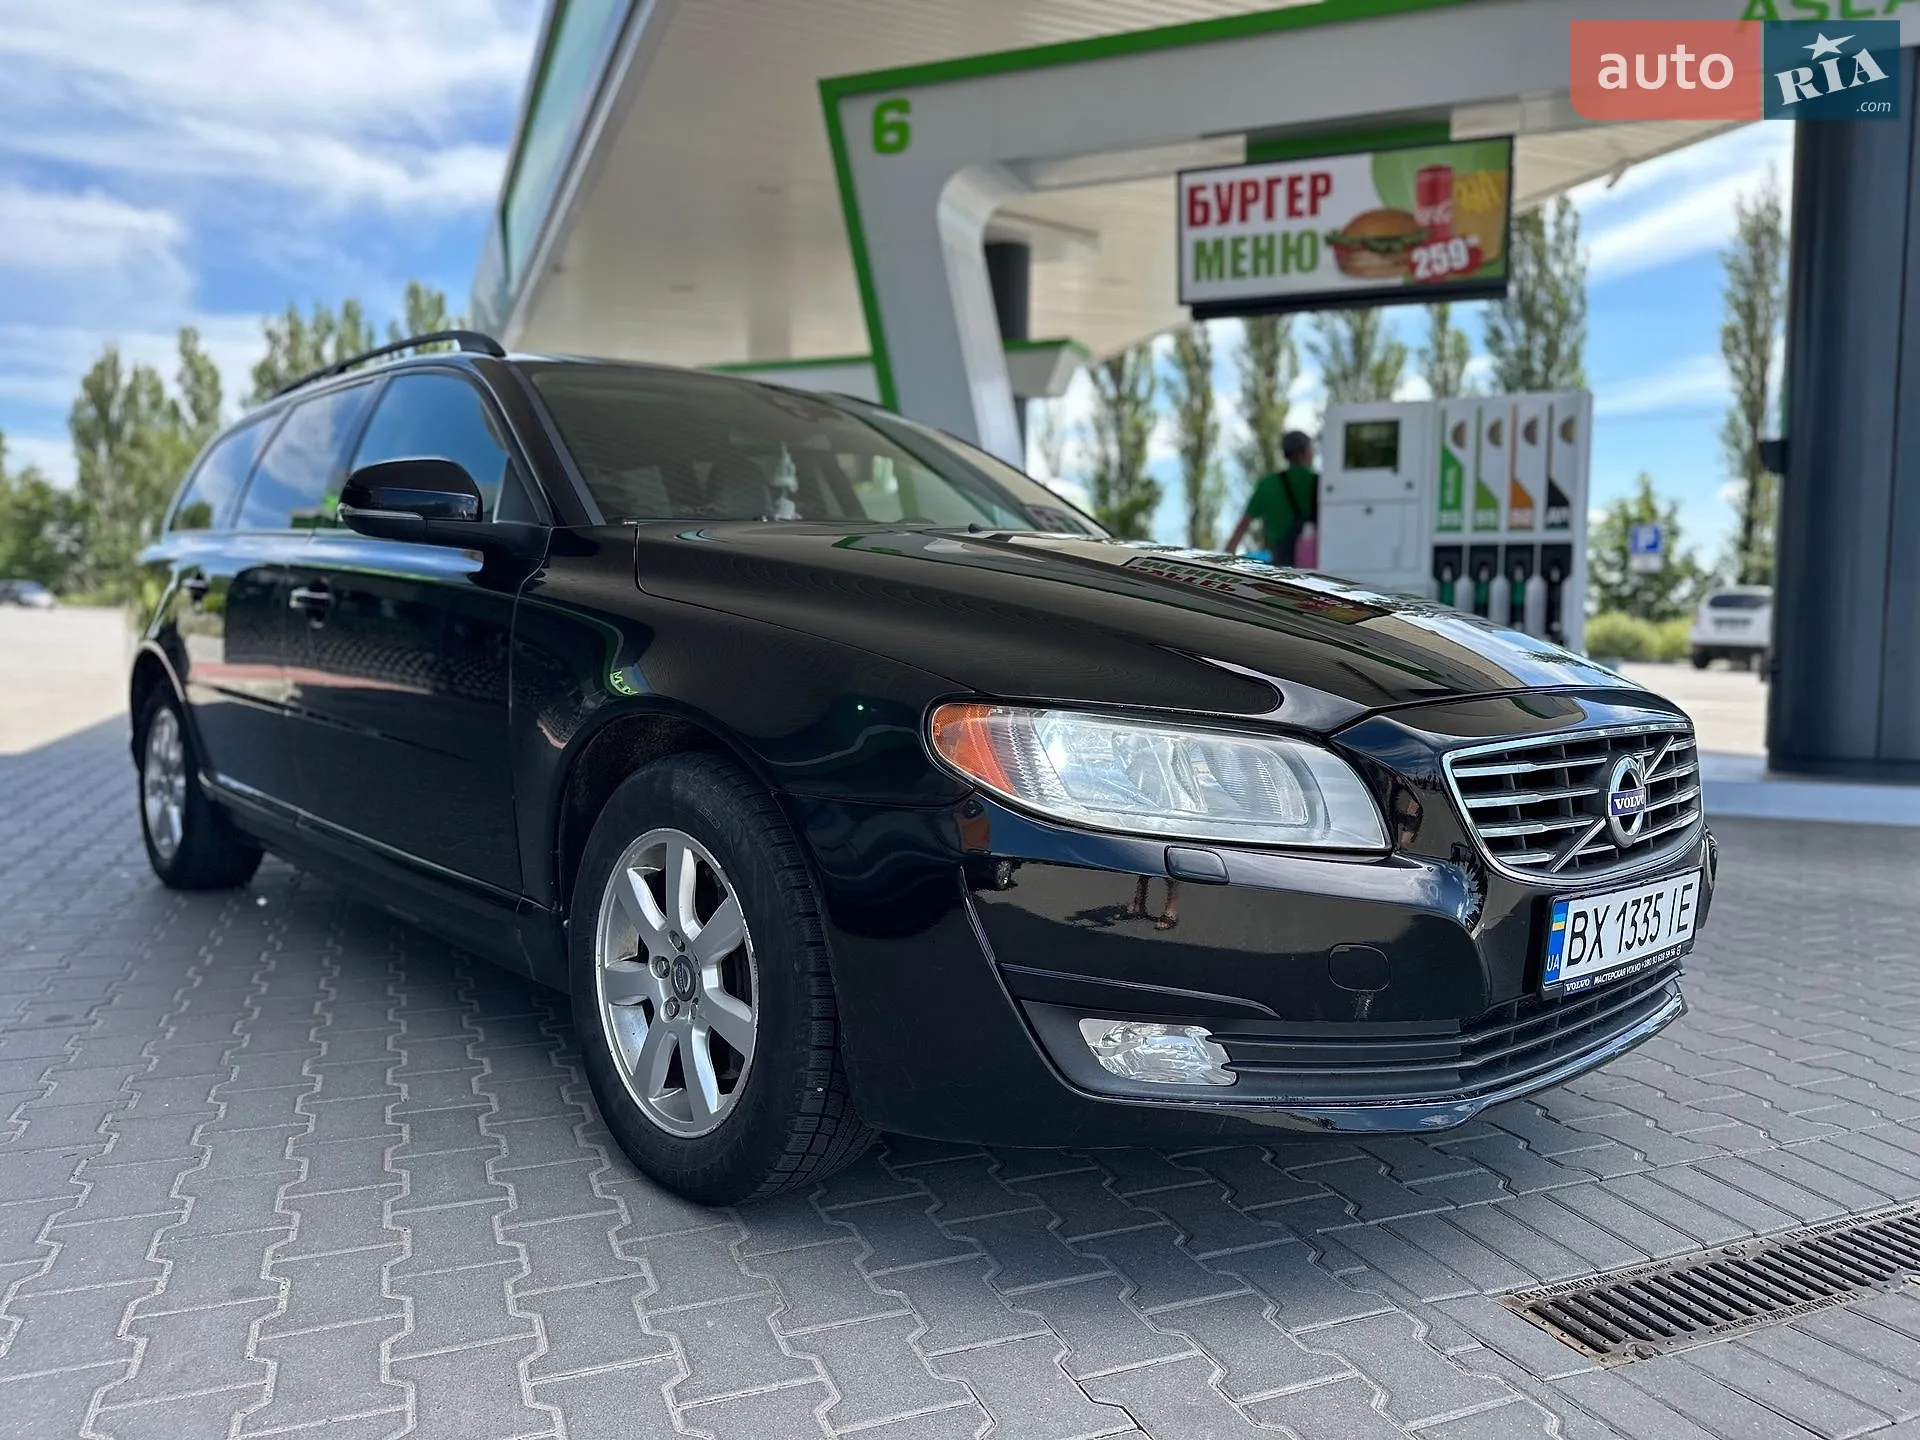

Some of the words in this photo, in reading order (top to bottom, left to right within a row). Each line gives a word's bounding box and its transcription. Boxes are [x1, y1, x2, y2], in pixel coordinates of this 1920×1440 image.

[872, 97, 912, 155] 6
[1187, 172, 1333, 228] БУРГЕР
[1193, 230, 1319, 283] МЕНЮ
[1567, 904, 1611, 967] BX
[1615, 891, 1664, 954] 1335
[1668, 882, 1693, 937] IE
[1546, 953, 1560, 972] UA
[1565, 978, 1591, 992] VOLVO
